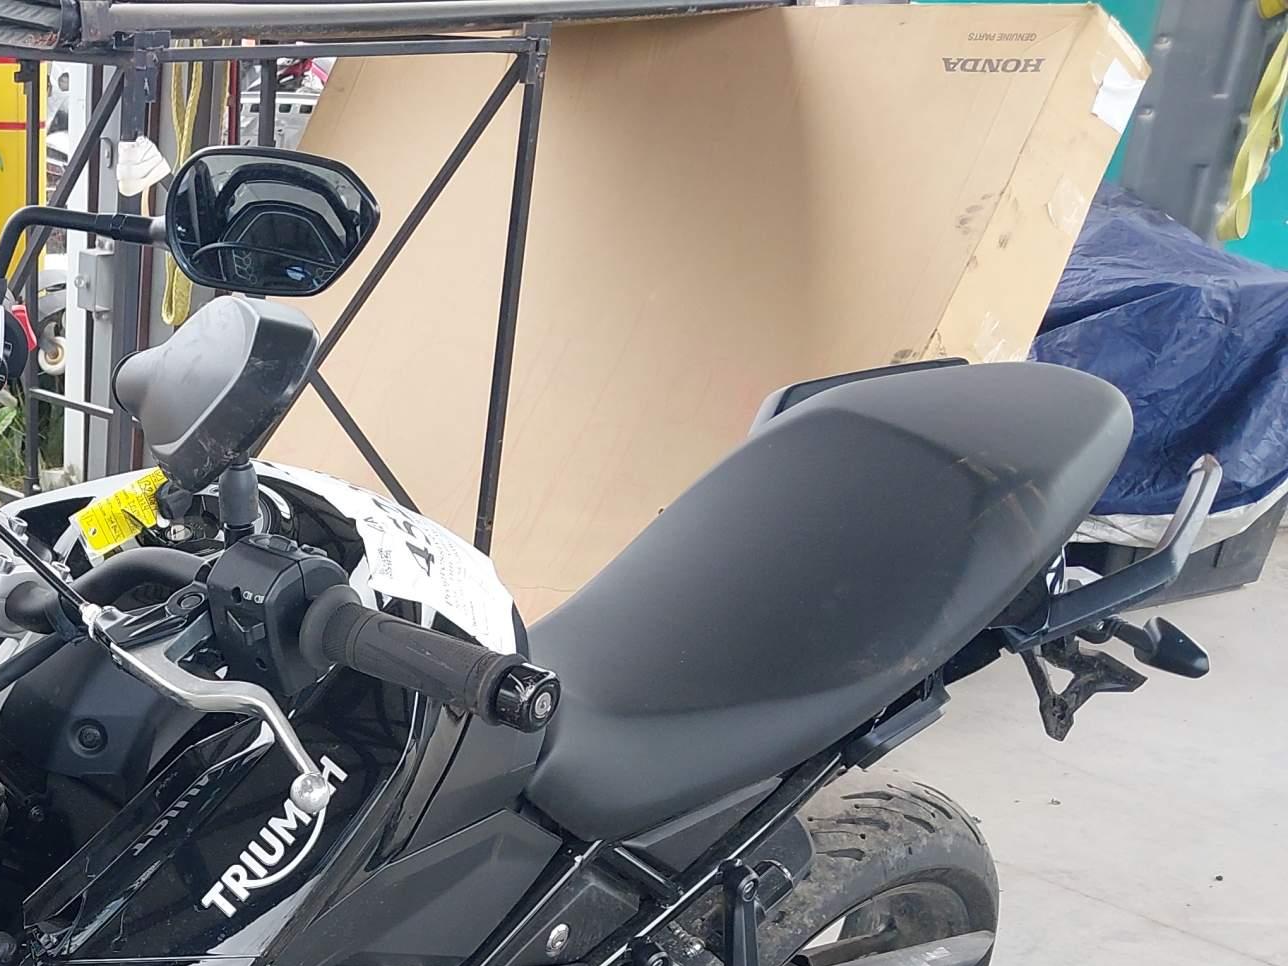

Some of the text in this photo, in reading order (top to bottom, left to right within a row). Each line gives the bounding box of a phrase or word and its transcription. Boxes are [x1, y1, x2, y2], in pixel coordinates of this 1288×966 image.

[967, 32, 1037, 42] GENUINE PARTS
[942, 57, 1044, 73] HONDA
